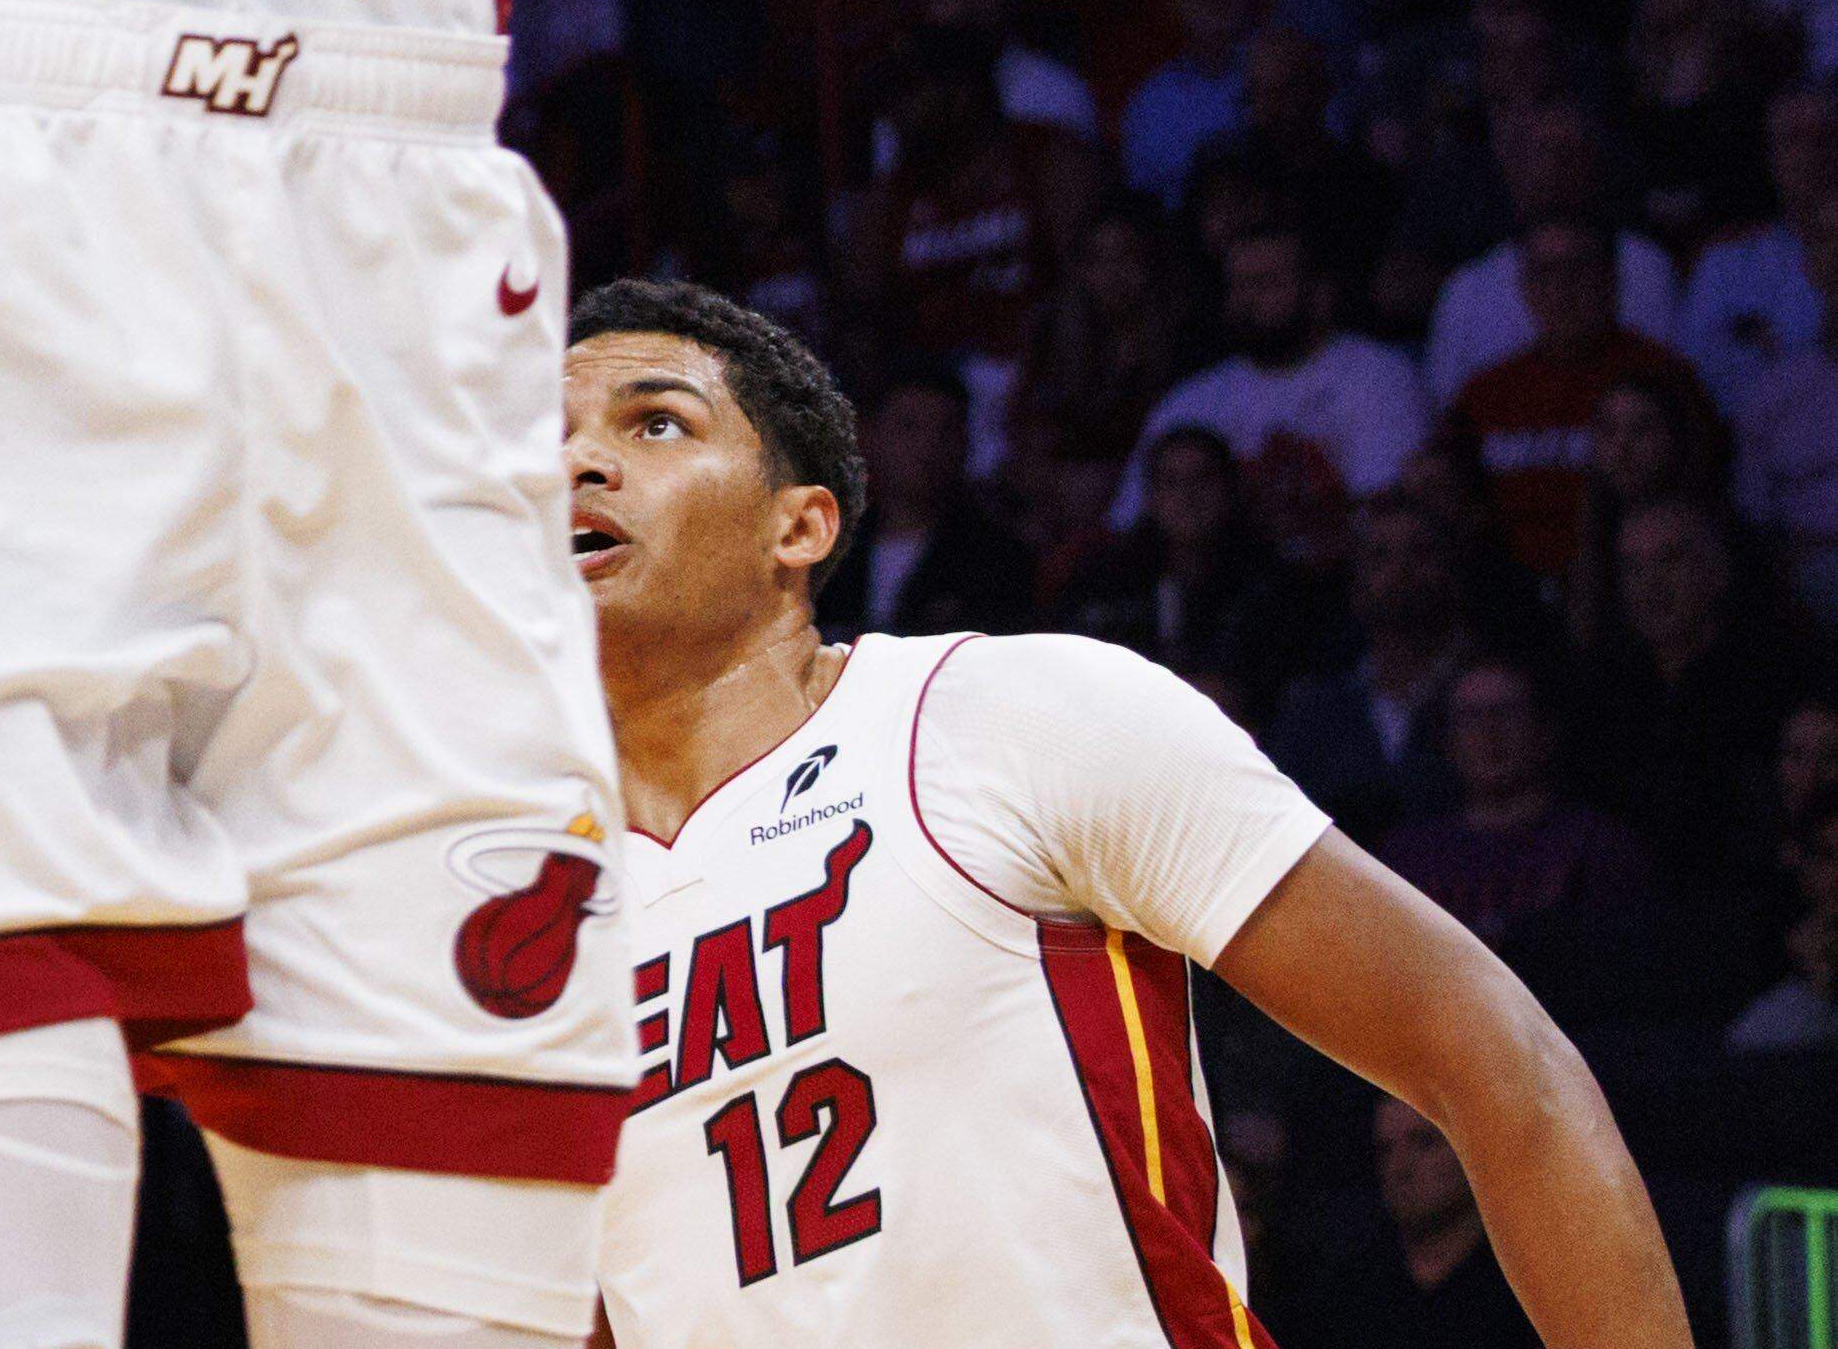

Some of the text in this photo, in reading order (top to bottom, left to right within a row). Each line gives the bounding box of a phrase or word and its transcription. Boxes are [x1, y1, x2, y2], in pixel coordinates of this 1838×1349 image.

[750, 791, 864, 845] Robinhood
[623, 817, 874, 1120] EAT
[703, 1056, 882, 1289] 12
